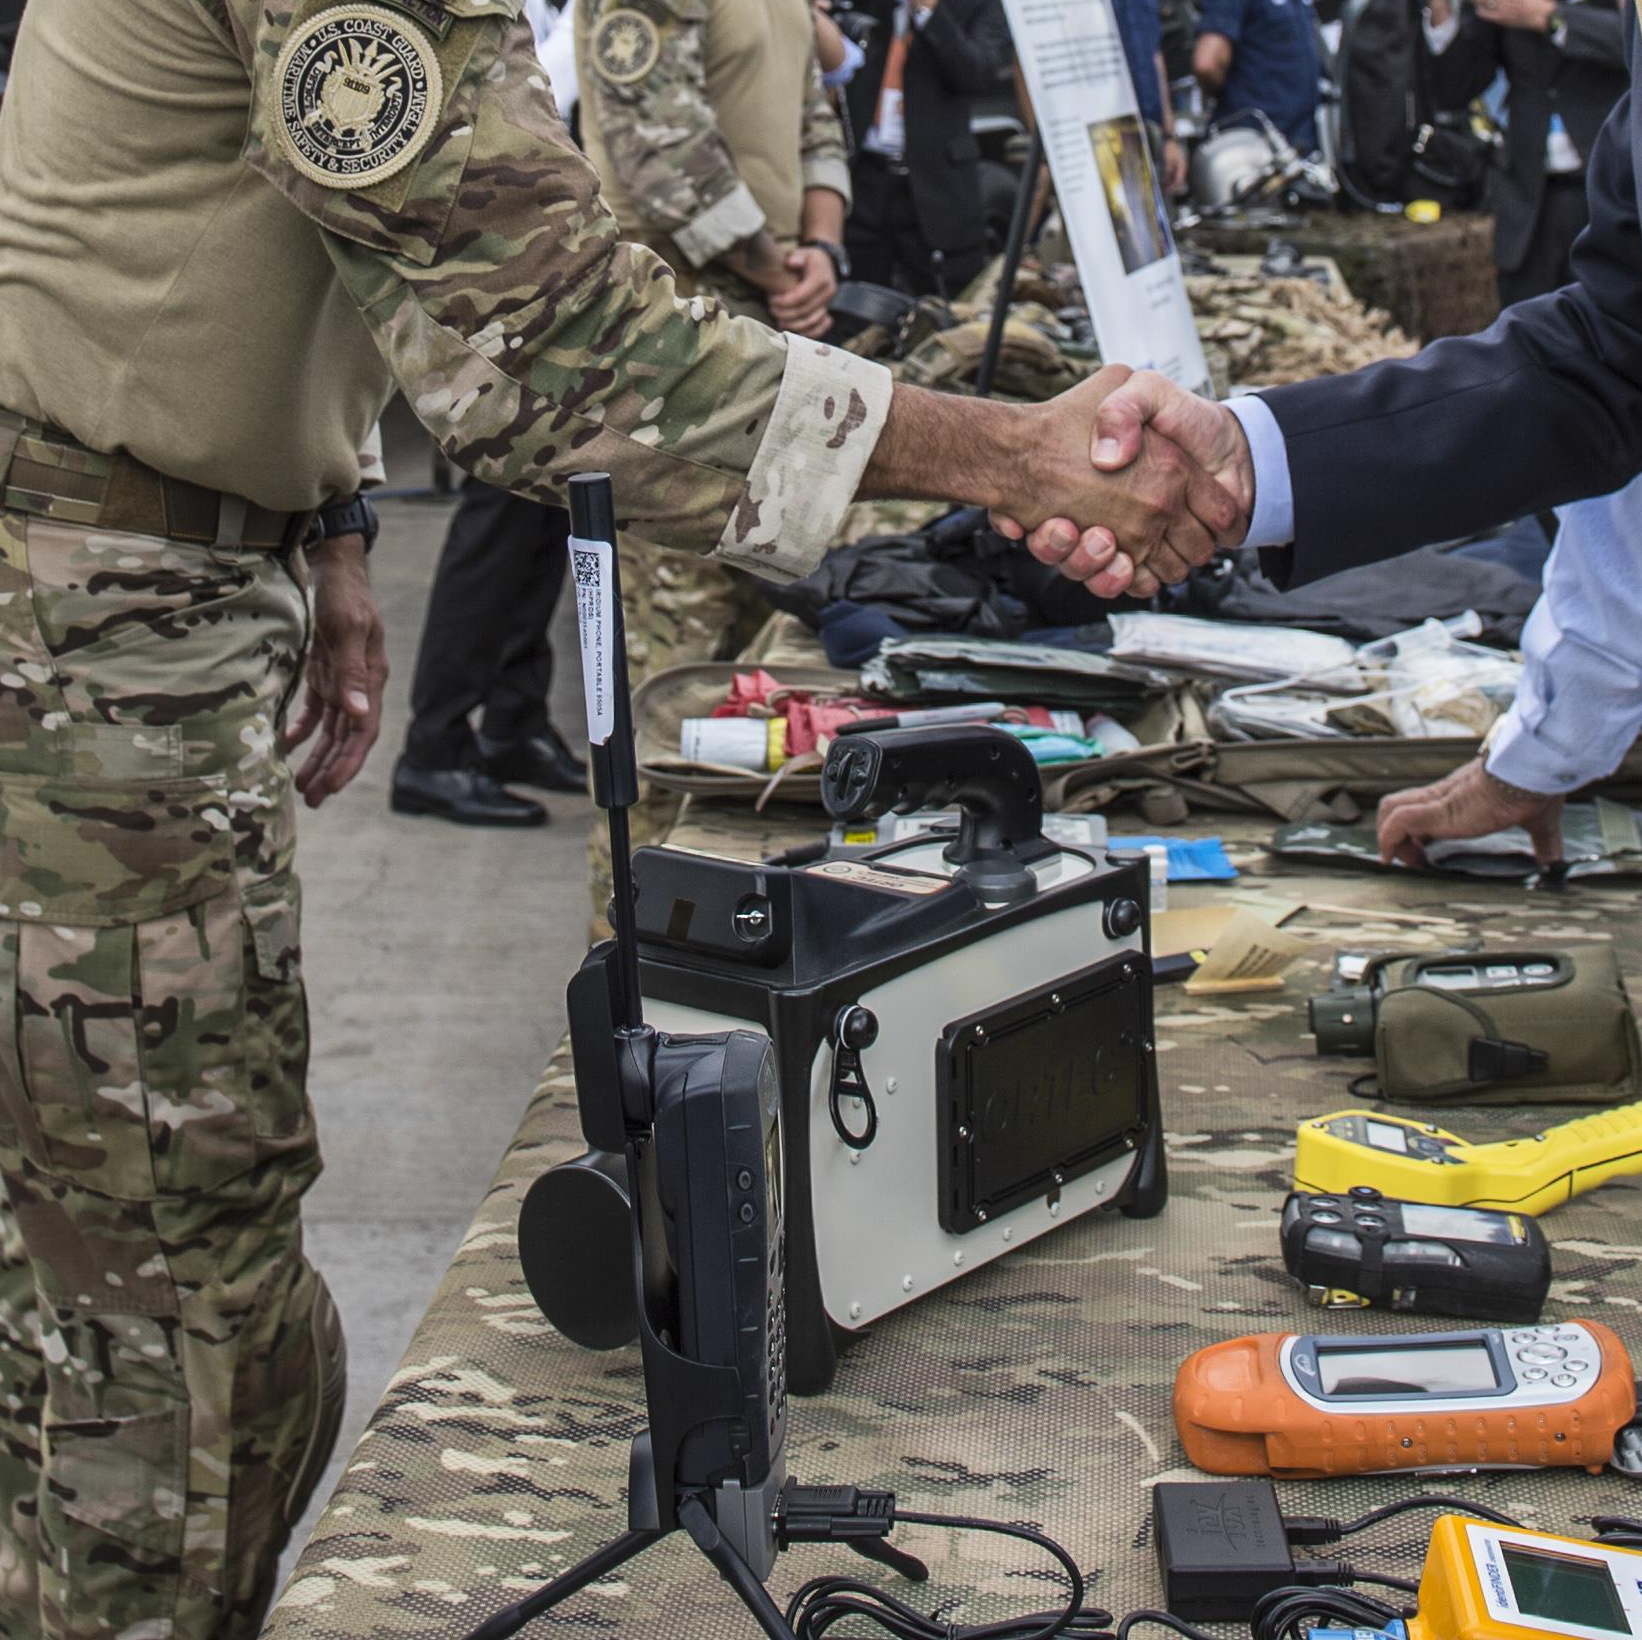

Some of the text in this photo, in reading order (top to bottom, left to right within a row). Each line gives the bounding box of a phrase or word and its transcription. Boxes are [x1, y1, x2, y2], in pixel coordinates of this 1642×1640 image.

[317, 20, 425, 80] U.S. COAST GUARD
[283, 43, 427, 174] MARITIME SAFETY & SECURITY TEAM
